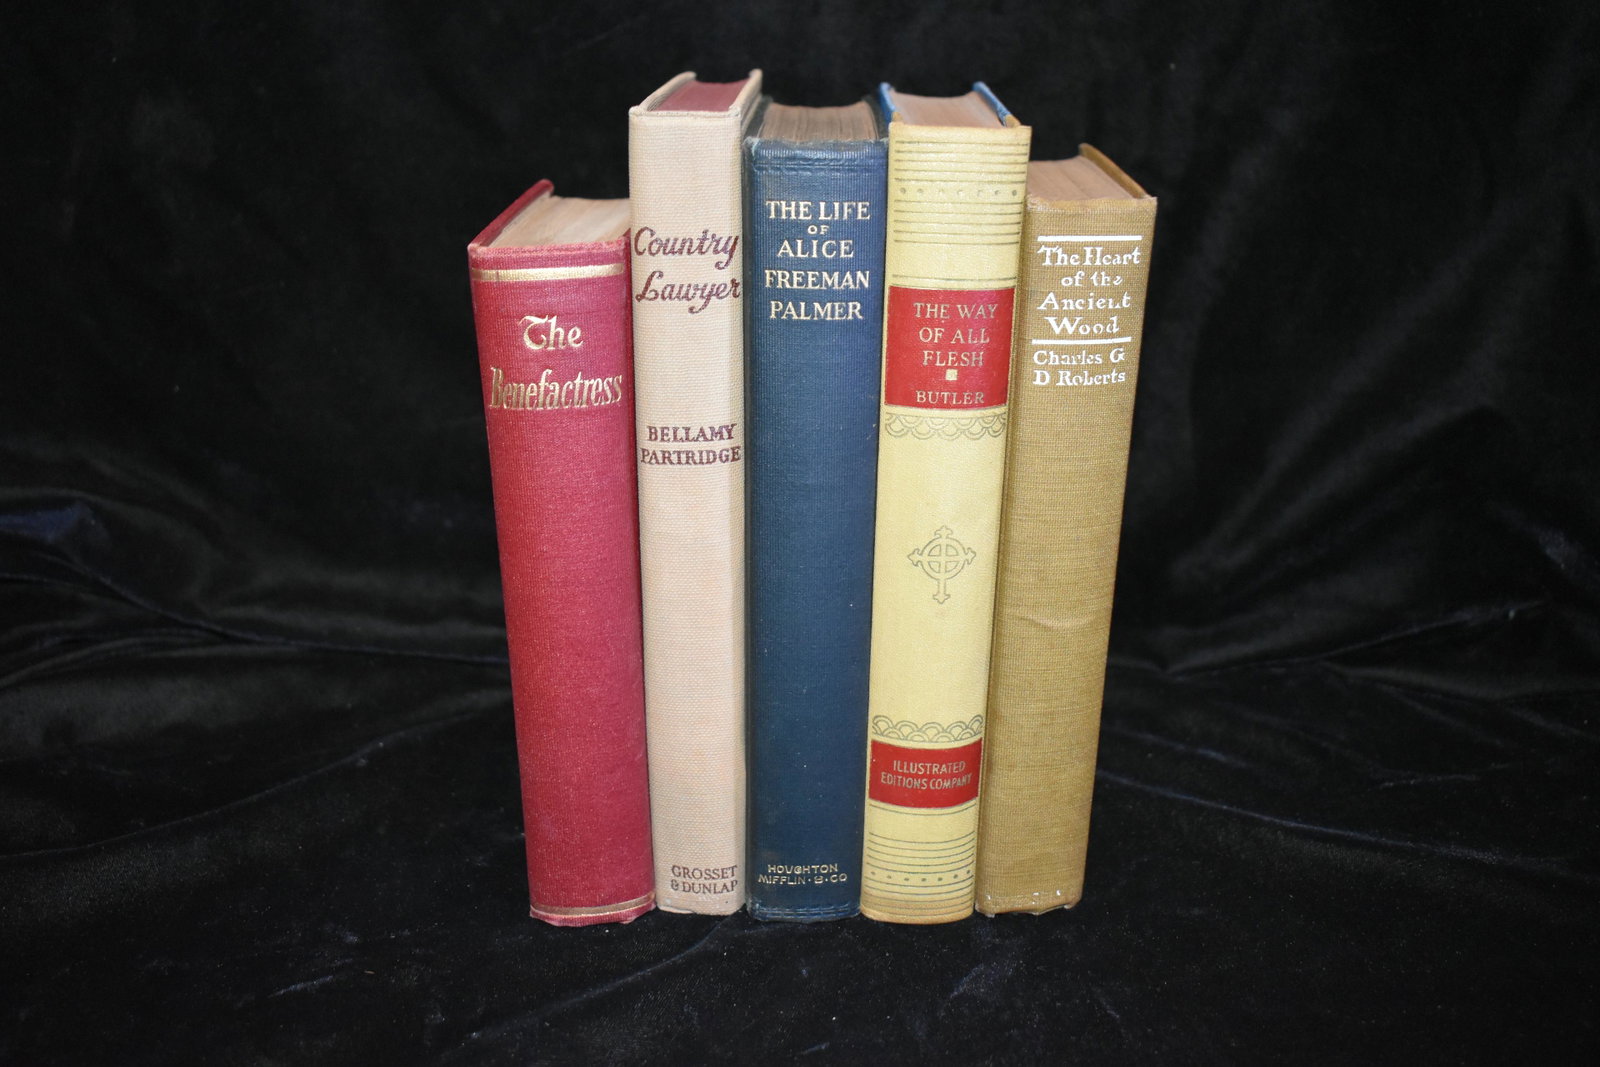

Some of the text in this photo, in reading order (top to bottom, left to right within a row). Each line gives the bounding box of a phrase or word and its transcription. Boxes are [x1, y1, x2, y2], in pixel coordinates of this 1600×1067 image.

[765, 200, 871, 220] THE LIFE
[807, 225, 829, 235] OF
[634, 226, 739, 270] Country
[777, 239, 854, 258] ALICE
[1037, 244, 1142, 266] The Heart
[764, 269, 870, 290] FREEMAN
[1060, 270, 1123, 287] of the
[635, 270, 741, 314] Lawyer
[1036, 291, 1131, 310] Ancient
[769, 300, 863, 321] PALMER
[913, 302, 999, 320] THE WAY
[517, 314, 584, 350] The
[1044, 316, 1120, 335] Wood
[919, 327, 990, 344] OF ALL
[922, 350, 985, 367] FLESH
[1032, 347, 1126, 366] Charles G
[1032, 367, 1126, 387] D Roberts
[489, 364, 623, 411] Benefactress
[915, 390, 985, 405] BUTLER
[647, 423, 738, 443] BELLAMY
[640, 445, 742, 466] PARTRIDGE
[893, 760, 967, 776] ILLUSTRATED
[880, 771, 973, 790] EDITIONS COMPANY
[671, 864, 738, 881] GROSSET
[767, 863, 839, 875] HOUGHTON
[670, 879, 738, 895] & DUNLAP
